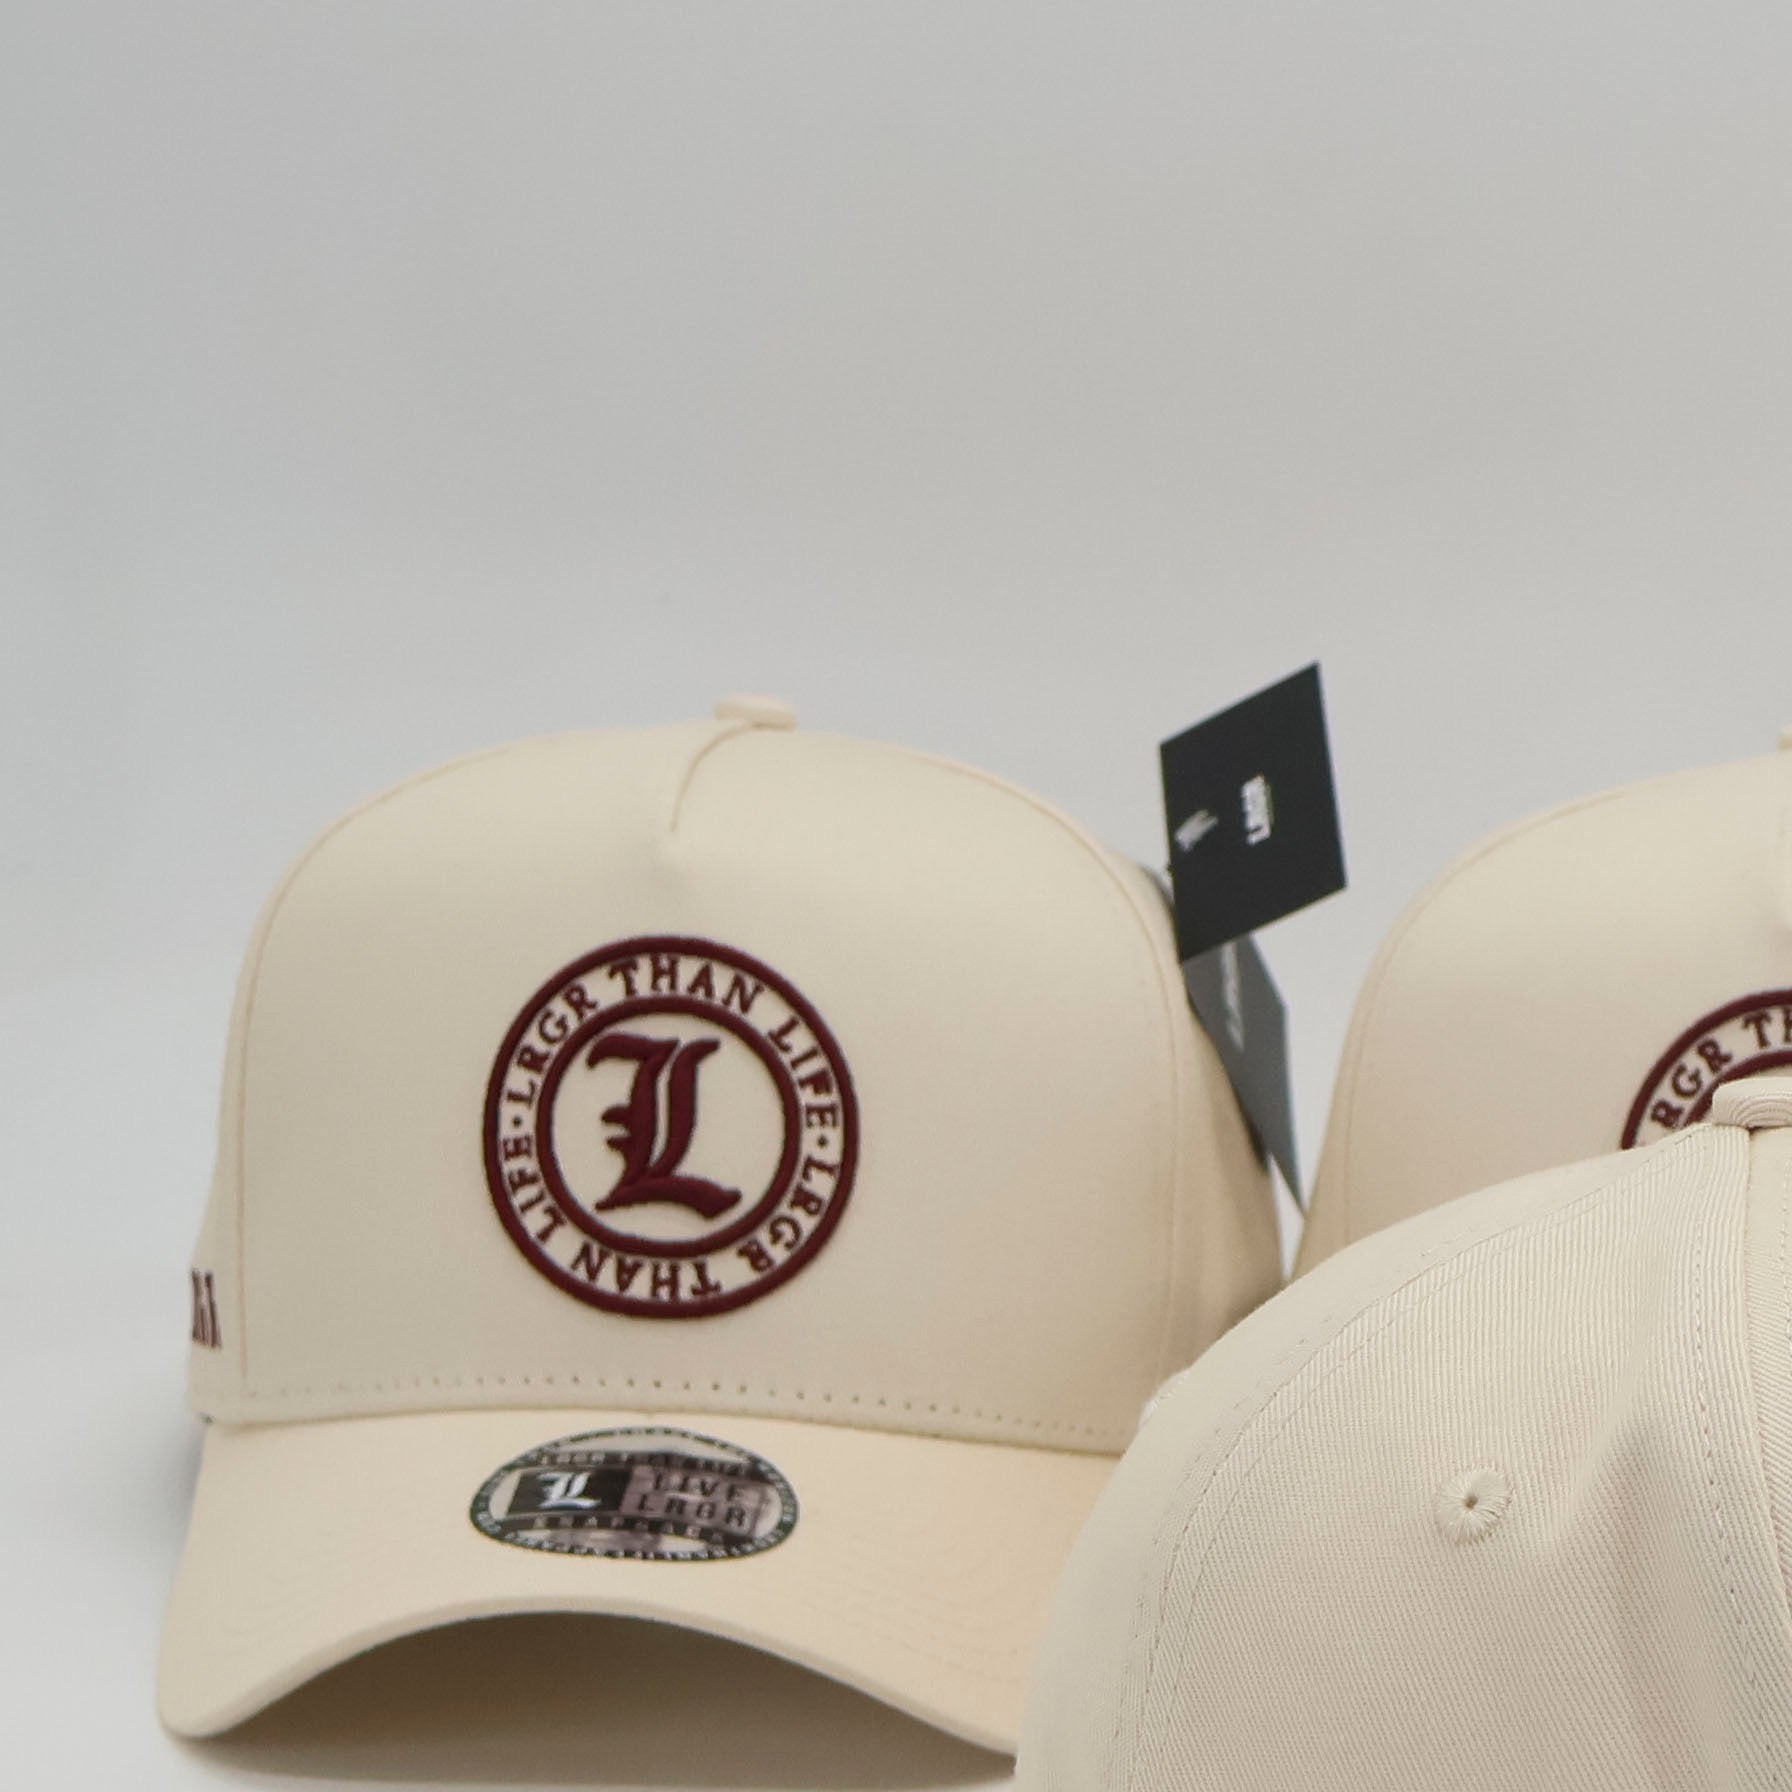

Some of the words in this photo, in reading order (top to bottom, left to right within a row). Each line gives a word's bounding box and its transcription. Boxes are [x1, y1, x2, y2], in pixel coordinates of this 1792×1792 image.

[506, 982, 598, 1106] LRGR
[607, 953, 764, 1014] THAN
[767, 1015, 839, 1130] LIFE
[1650, 1038, 1733, 1130] RGR
[502, 1135, 567, 1244] LIFE
[736, 1155, 840, 1274] LRGR
[570, 1239, 722, 1301] THAN
